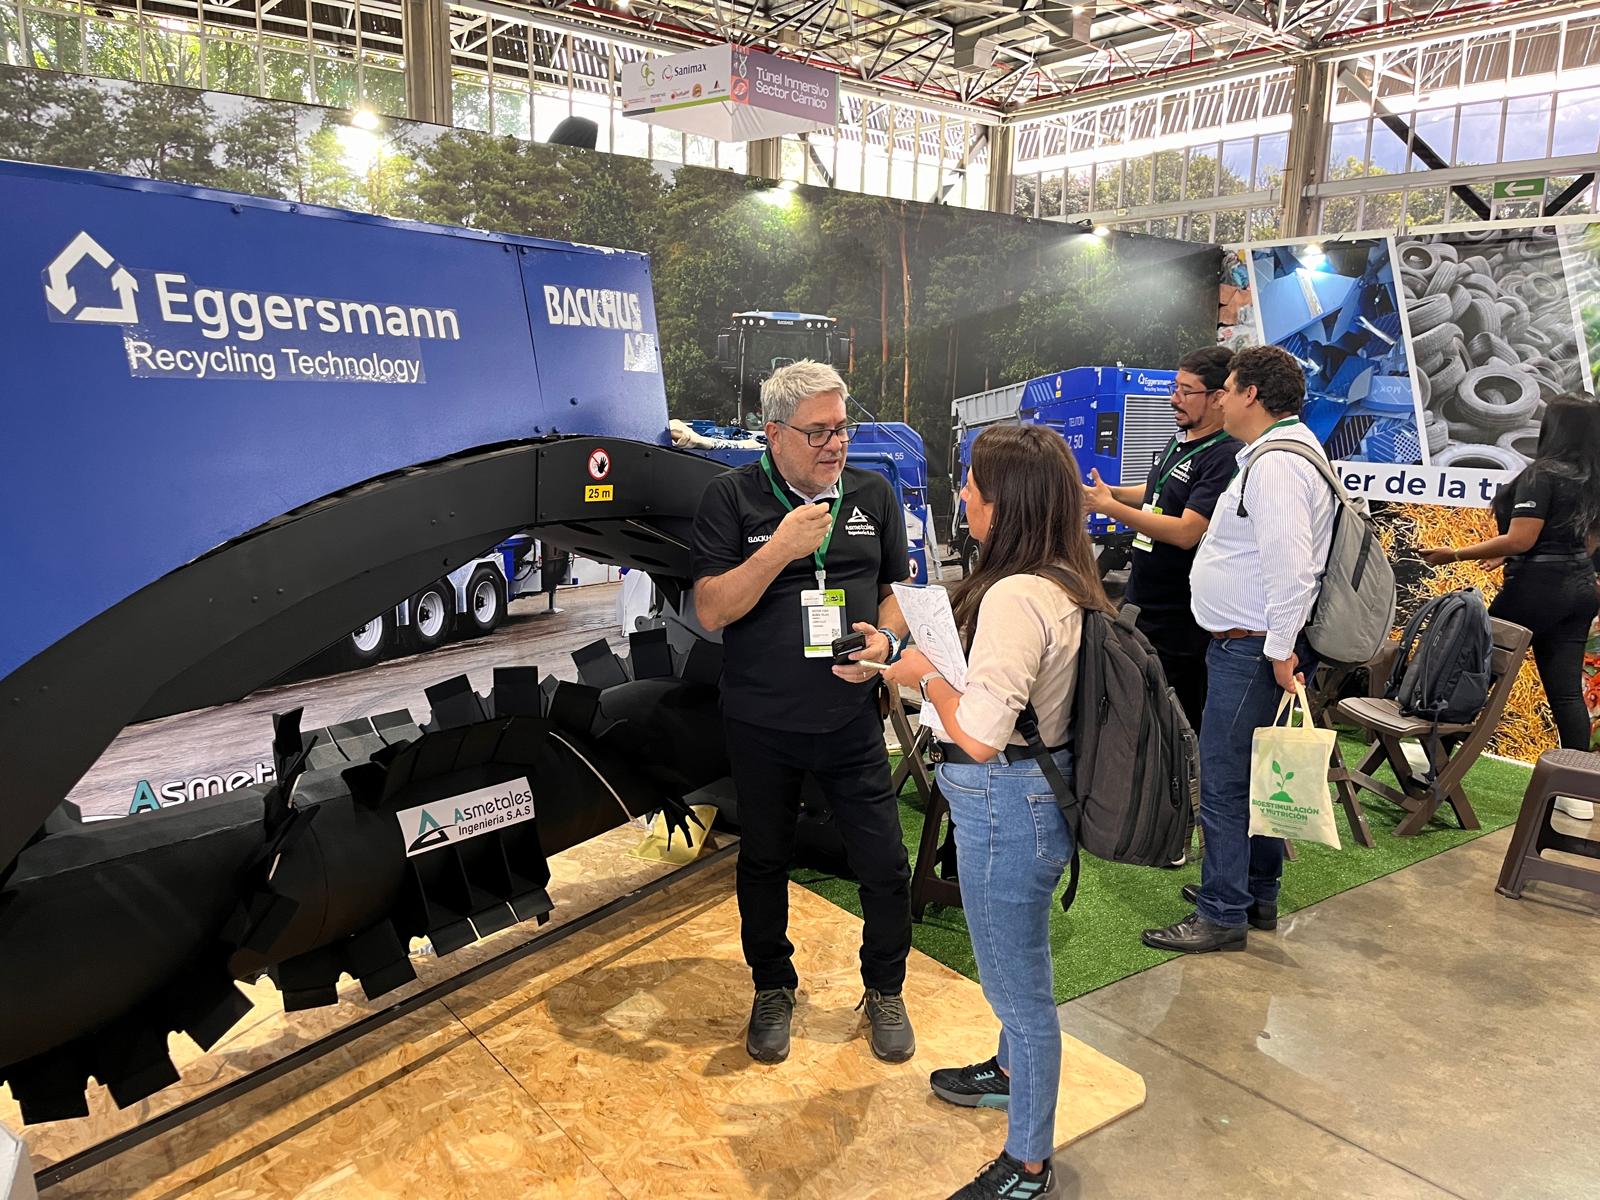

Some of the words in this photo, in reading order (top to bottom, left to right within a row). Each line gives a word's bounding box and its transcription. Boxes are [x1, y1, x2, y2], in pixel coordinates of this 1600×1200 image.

[674, 63, 707, 77] Sanimax
[756, 66, 783, 86] Túnel
[784, 73, 830, 98] Inmersivo
[755, 80, 790, 99] Sector
[791, 89, 827, 110] Cárnico
[154, 272, 461, 341] Eggersmann
[543, 284, 643, 332] BACKHUS
[128, 339, 277, 380] Recycling
[280, 347, 421, 383] Technology
[1073, 433, 1084, 449] 50
[588, 488, 600, 499] 25
[601, 489, 611, 498] m
[1385, 470, 1427, 496] de
[1438, 473, 1467, 500] la
[747, 534, 772, 543] BACKH
[128, 762, 276, 815] Asmet
[453, 790, 533, 826] Asmetales
[506, 804, 531, 821] S.A.S
[1251, 798, 1320, 816] BIOESTIMULACIÓN
[1266, 808, 1309, 821] NUTRICIÓN
